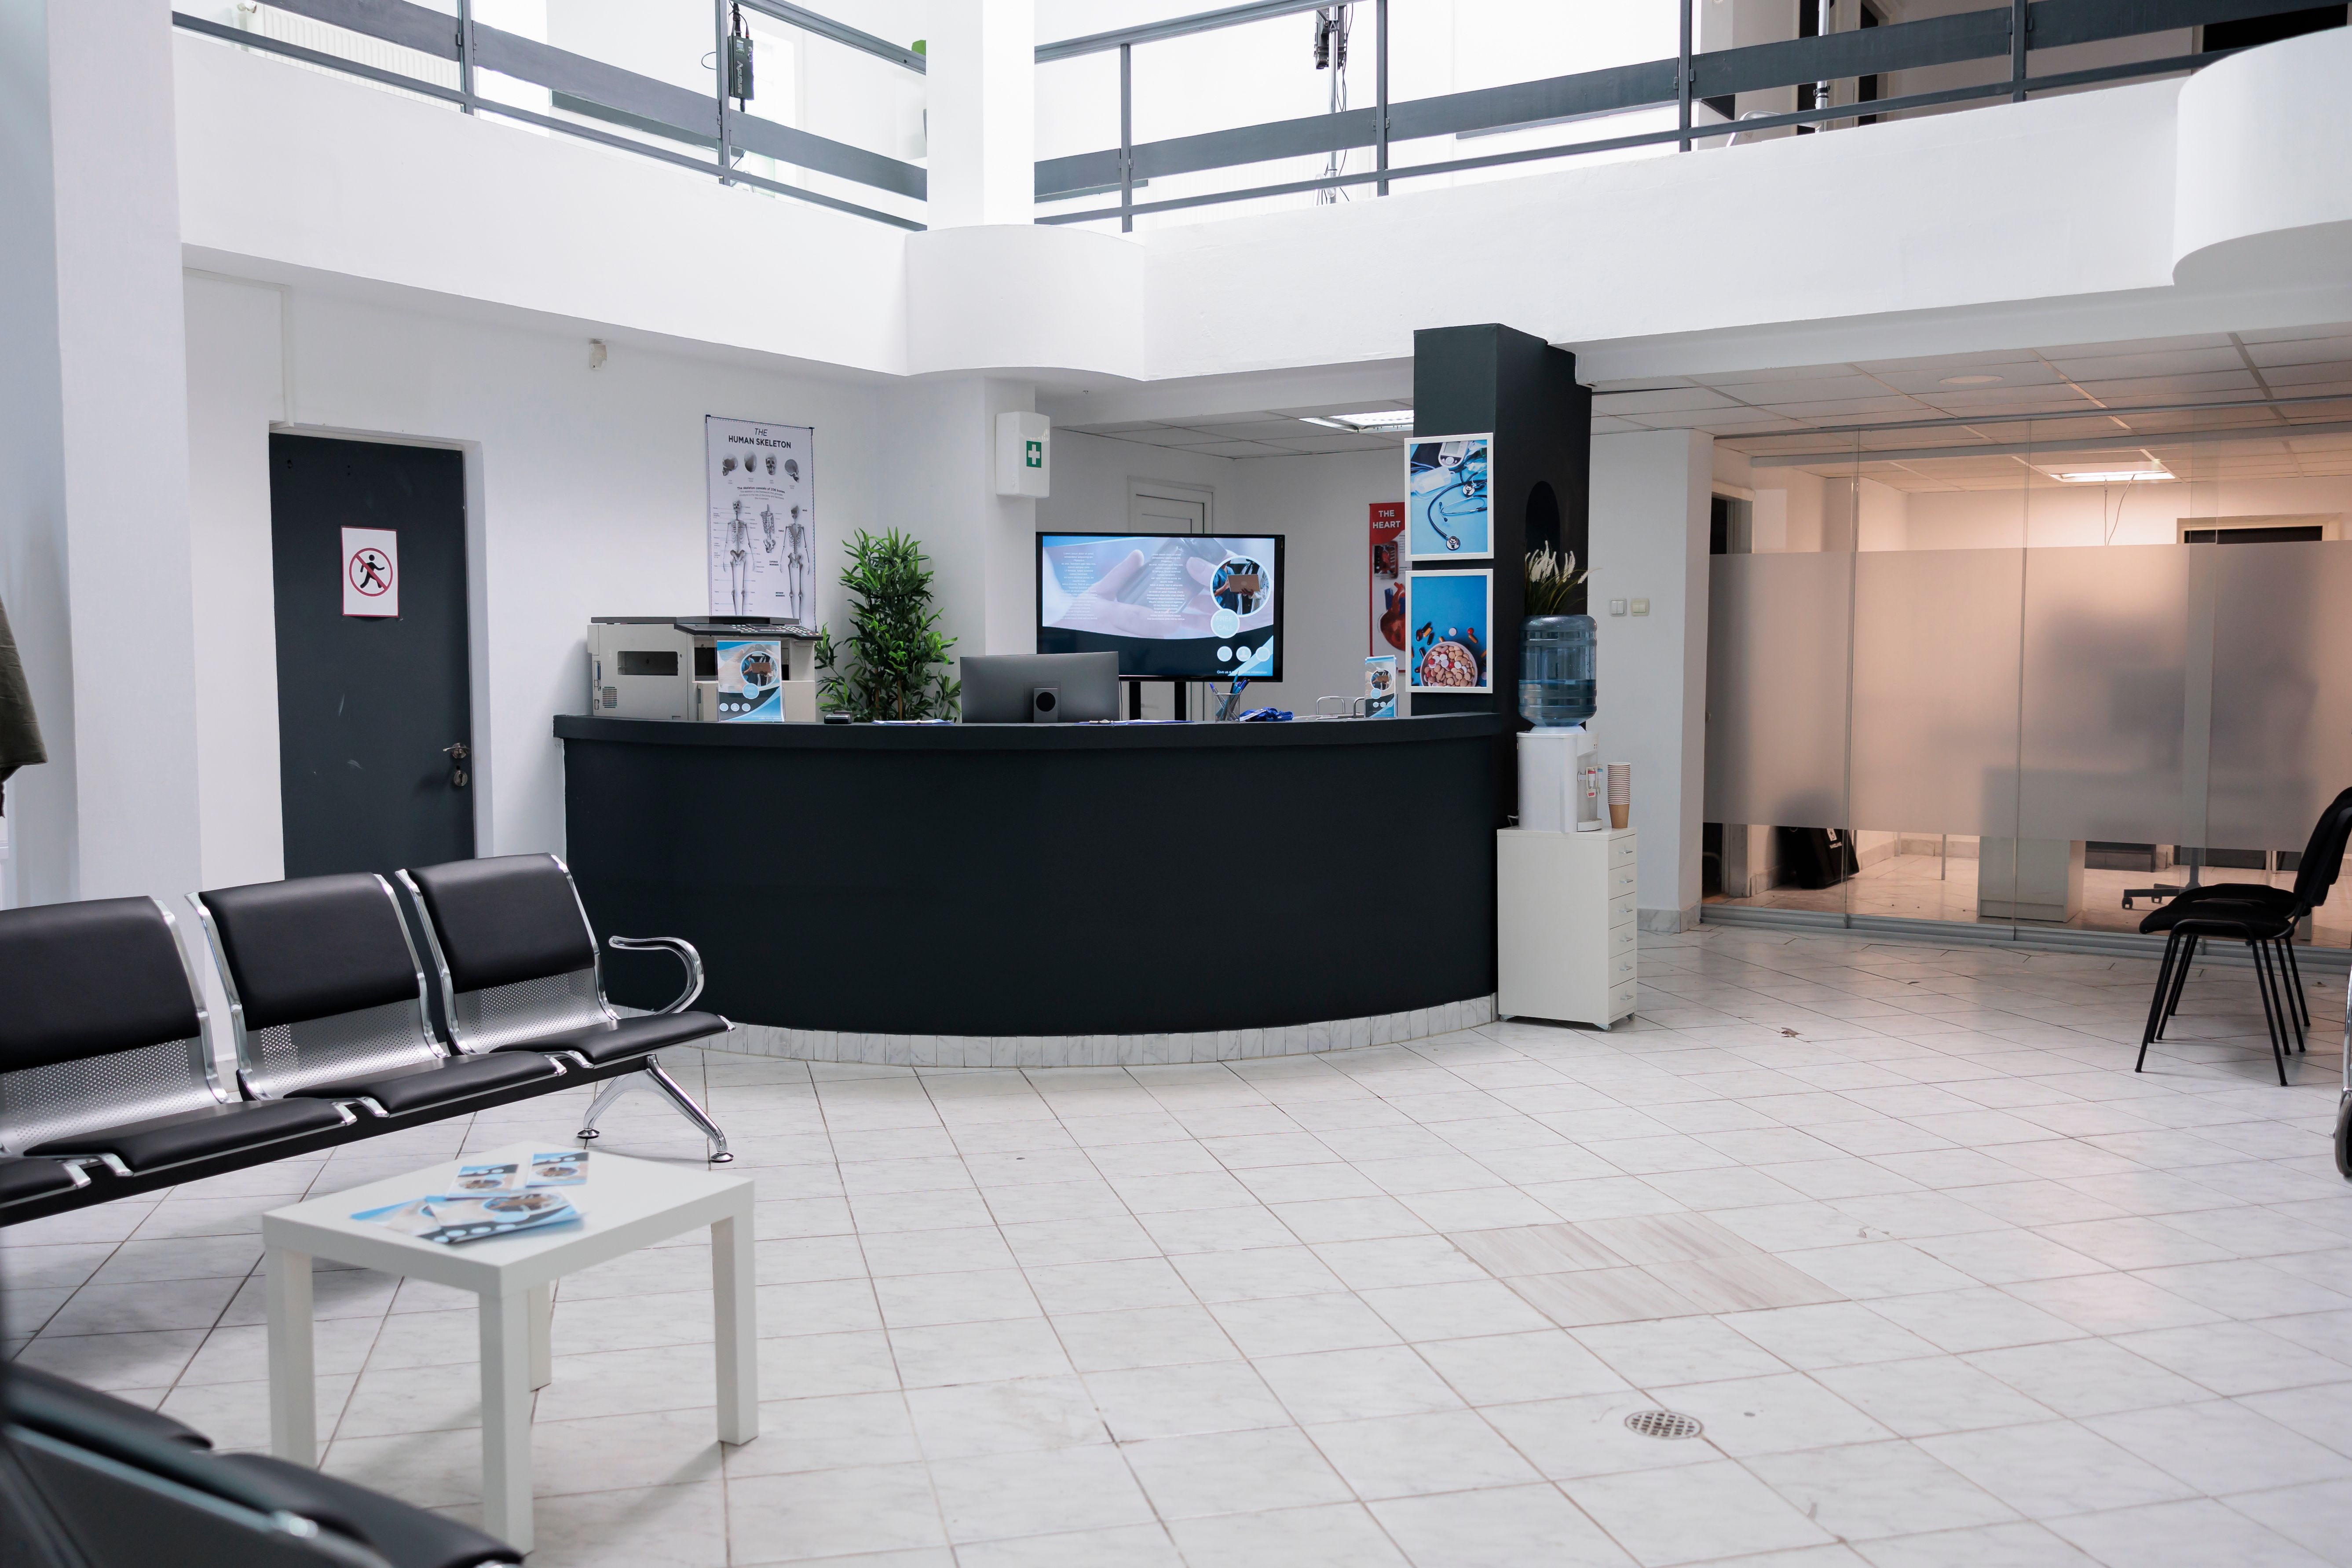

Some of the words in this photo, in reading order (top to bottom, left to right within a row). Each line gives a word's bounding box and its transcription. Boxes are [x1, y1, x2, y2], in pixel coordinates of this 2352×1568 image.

[755, 428, 768, 436] THE
[728, 435, 754, 445] HUMAN
[756, 438, 791, 449] SKELETON
[1373, 520, 1401, 529] HEART
